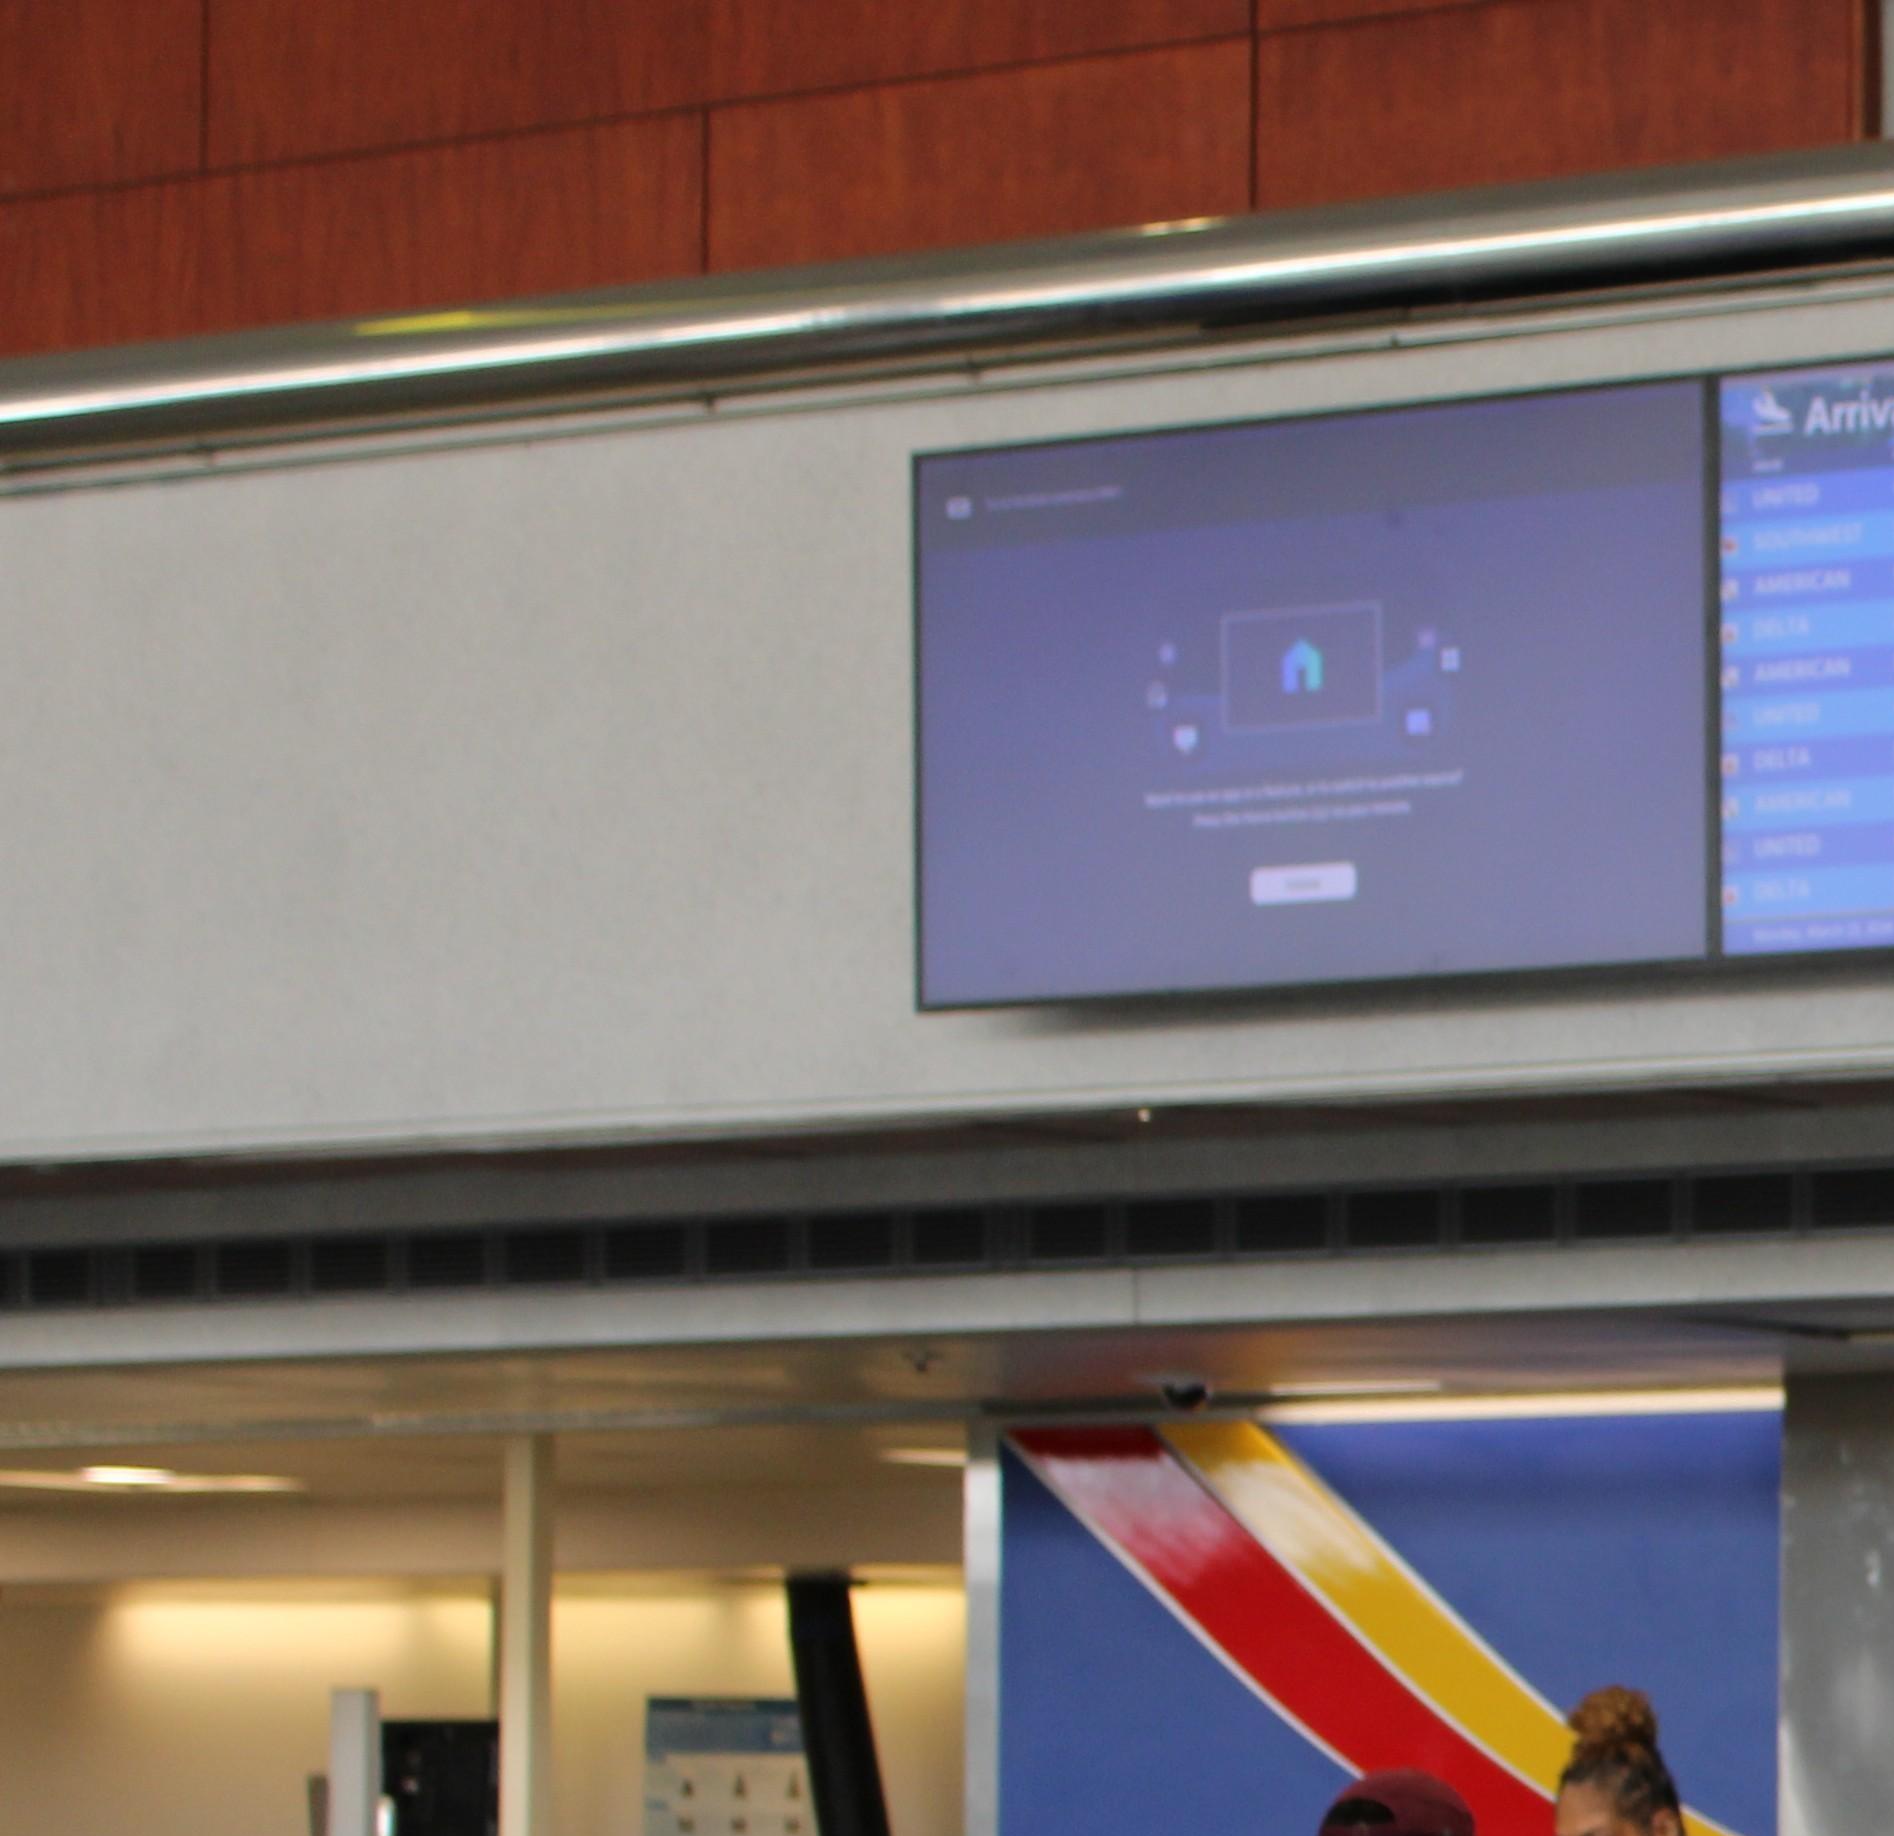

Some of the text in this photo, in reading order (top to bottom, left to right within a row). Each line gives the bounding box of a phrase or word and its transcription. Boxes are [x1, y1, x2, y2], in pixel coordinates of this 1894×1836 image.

[1752, 482, 1819, 508] UNITED
[1752, 567, 1850, 596] AMERICAN
[1754, 655, 1851, 683] AMERICAN
[1753, 746, 1810, 771] DELTA
